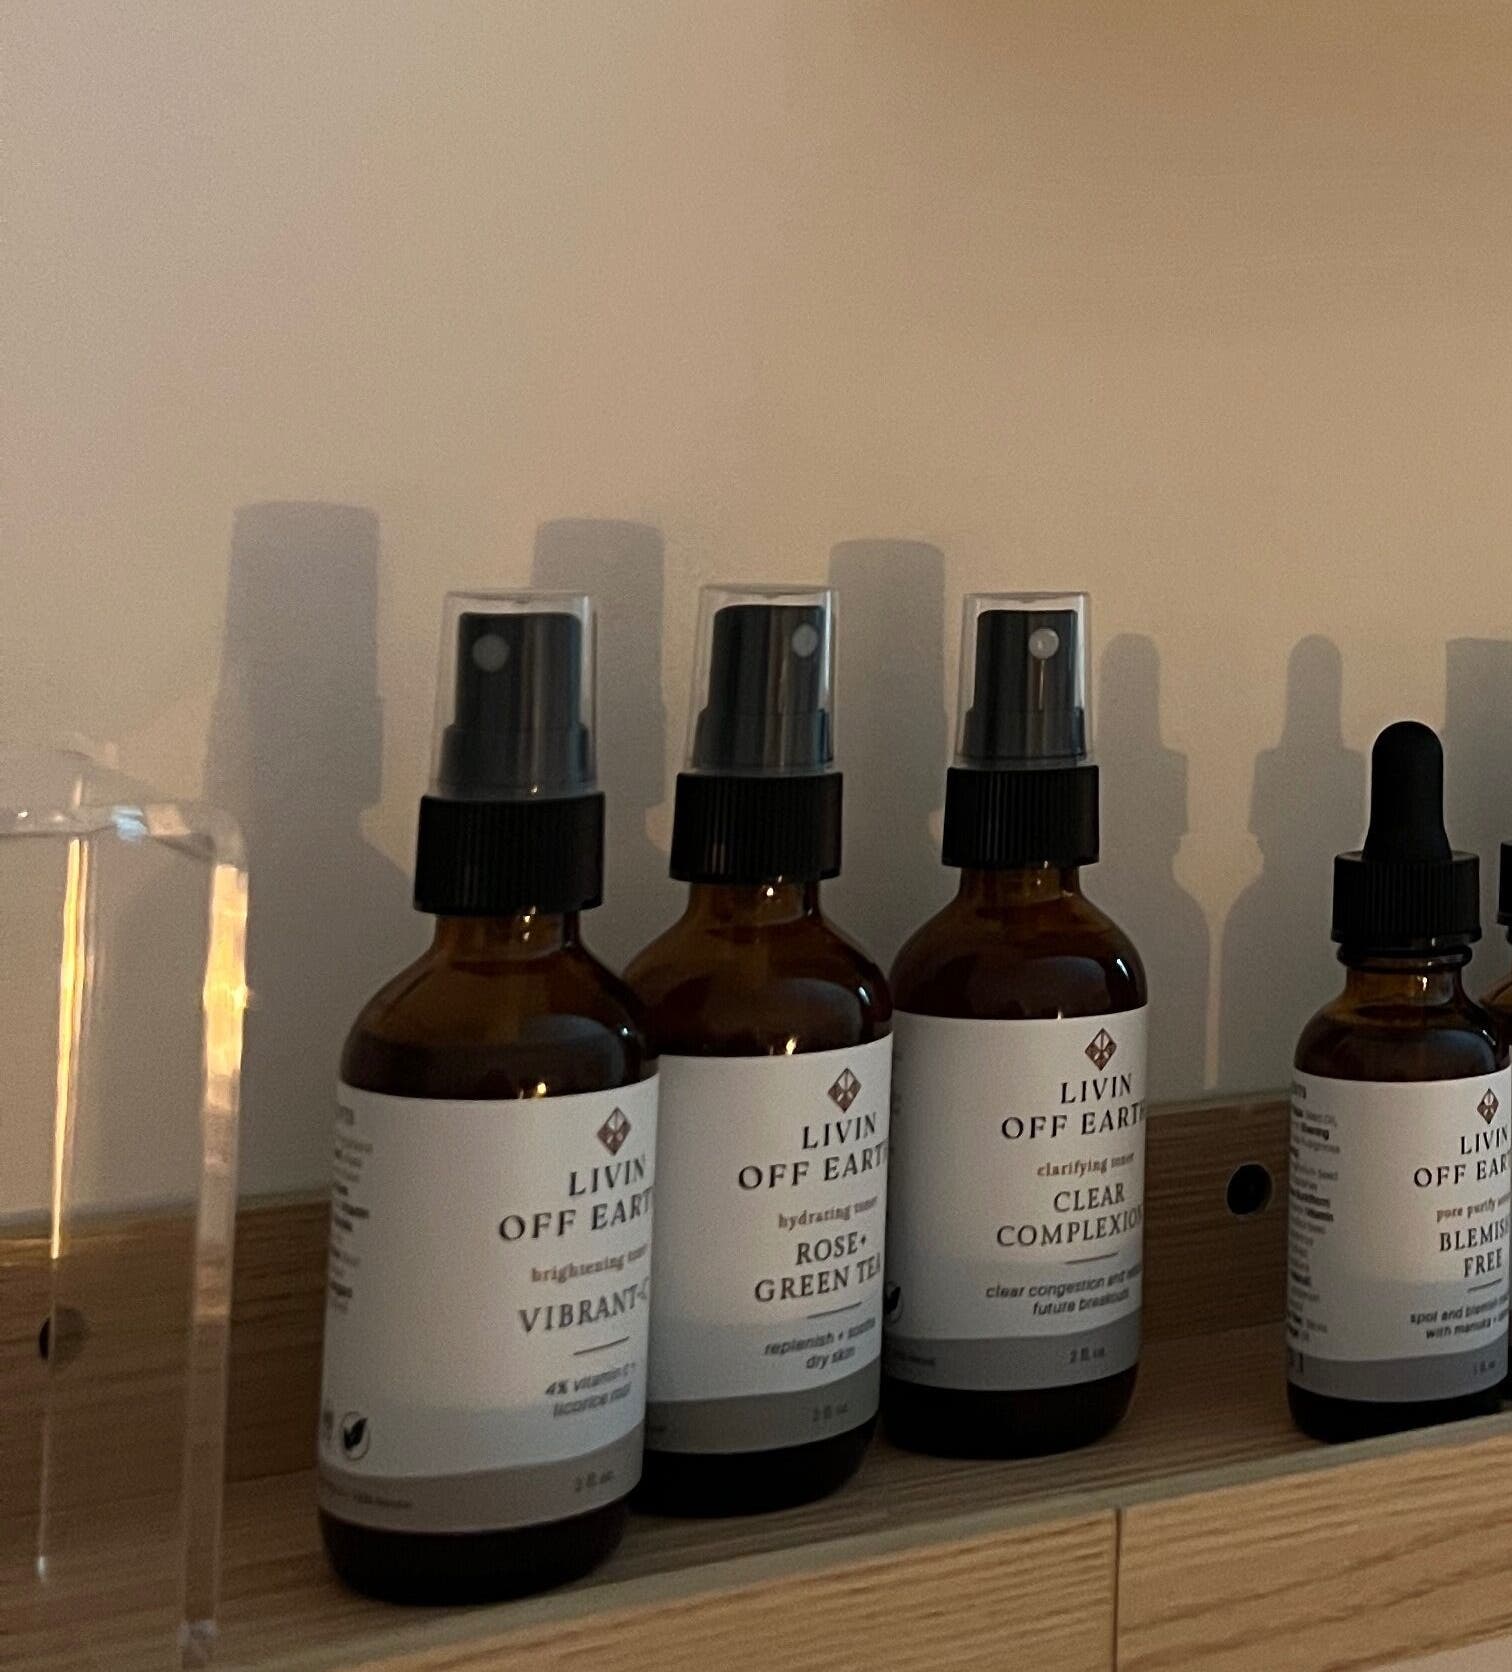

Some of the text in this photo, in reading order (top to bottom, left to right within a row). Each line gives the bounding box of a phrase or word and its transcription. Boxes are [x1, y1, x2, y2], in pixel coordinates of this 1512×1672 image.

[1060, 1072, 1133, 1105] LIVIN
[802, 1112, 877, 1150] LIVIN
[1001, 1114, 1068, 1141] OFF
[1459, 1125, 1509, 1156] LIVIN
[567, 1153, 646, 1197] LIVIN
[737, 1160, 810, 1191] OFF
[1036, 1157, 1109, 1178] clarifying
[1413, 1164, 1467, 1188] OFF
[1053, 1182, 1125, 1213] CLEAR
[499, 1185, 653, 1241] OFF EART
[778, 1205, 851, 1231] hydrating
[1436, 1207, 1464, 1224] pore
[531, 1253, 625, 1285] brightening
[1463, 1247, 1503, 1279] FREE
[754, 1265, 850, 1303] GREEN
[985, 1284, 1024, 1299] clear
[1028, 1276, 1106, 1300] congestion
[1032, 1301, 1076, 1316] future
[1409, 1310, 1439, 1326] spot
[1440, 1306, 1464, 1322] and
[763, 1331, 835, 1356] replenish
[1425, 1326, 1452, 1340] with
[805, 1353, 831, 1370] dry
